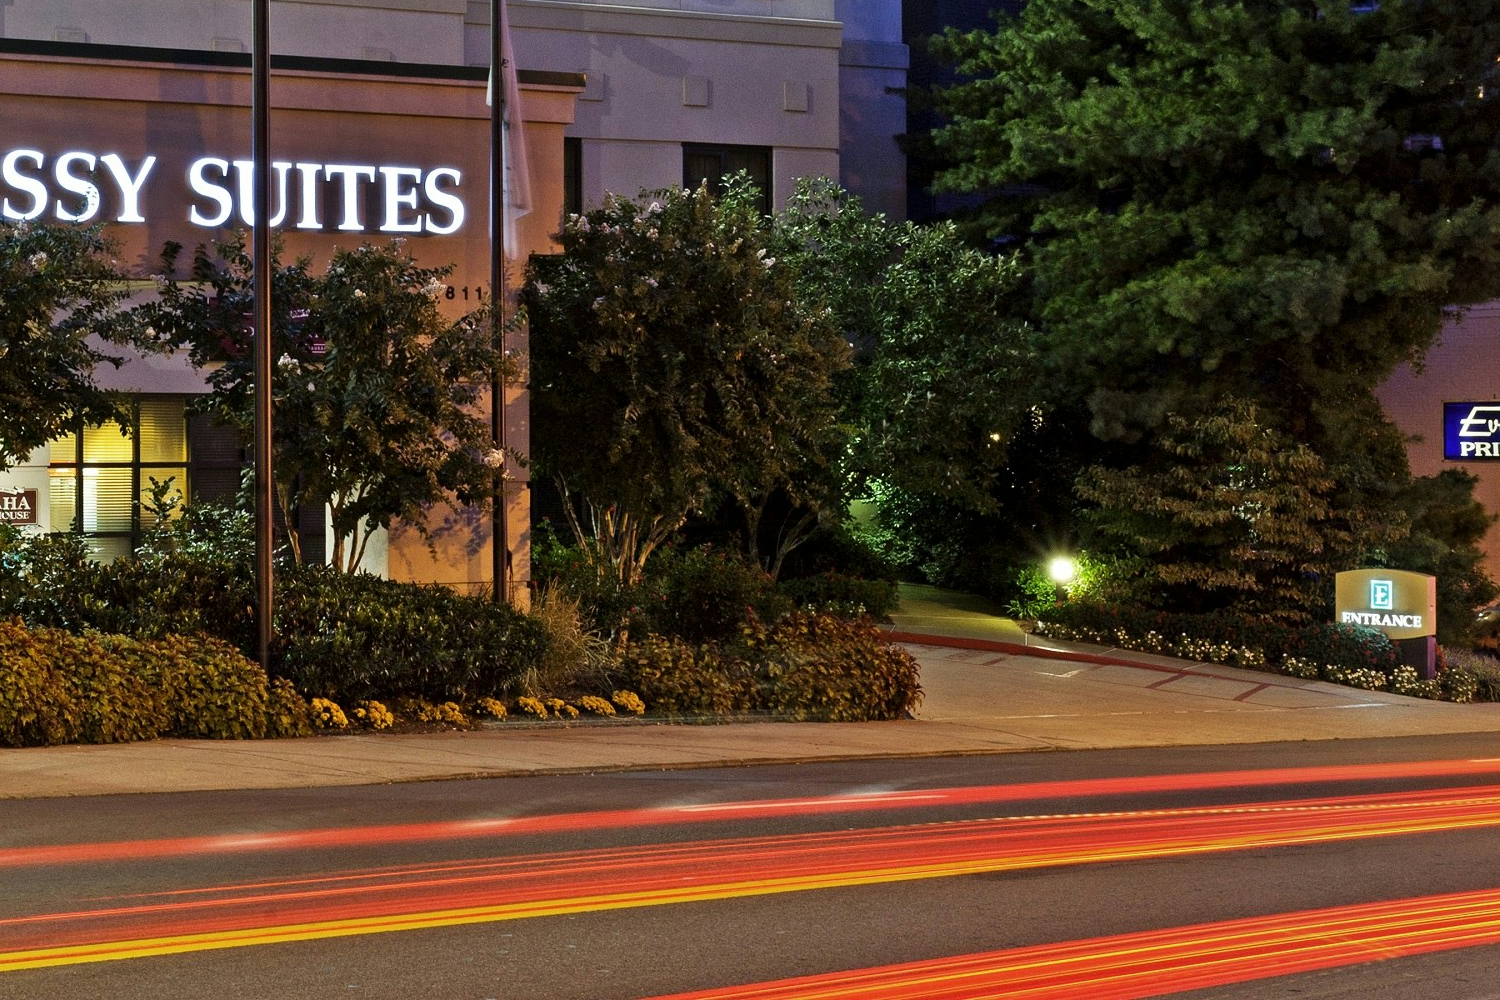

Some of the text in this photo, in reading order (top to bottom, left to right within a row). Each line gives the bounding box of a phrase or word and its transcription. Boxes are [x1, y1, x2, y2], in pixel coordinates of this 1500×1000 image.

[188, 157, 466, 235] SUITES
[433, 286, 482, 300] 811
[1460, 441, 1500, 457] PRI
[1375, 585, 1388, 605] E
[1342, 611, 1422, 628] ENTRANCE
